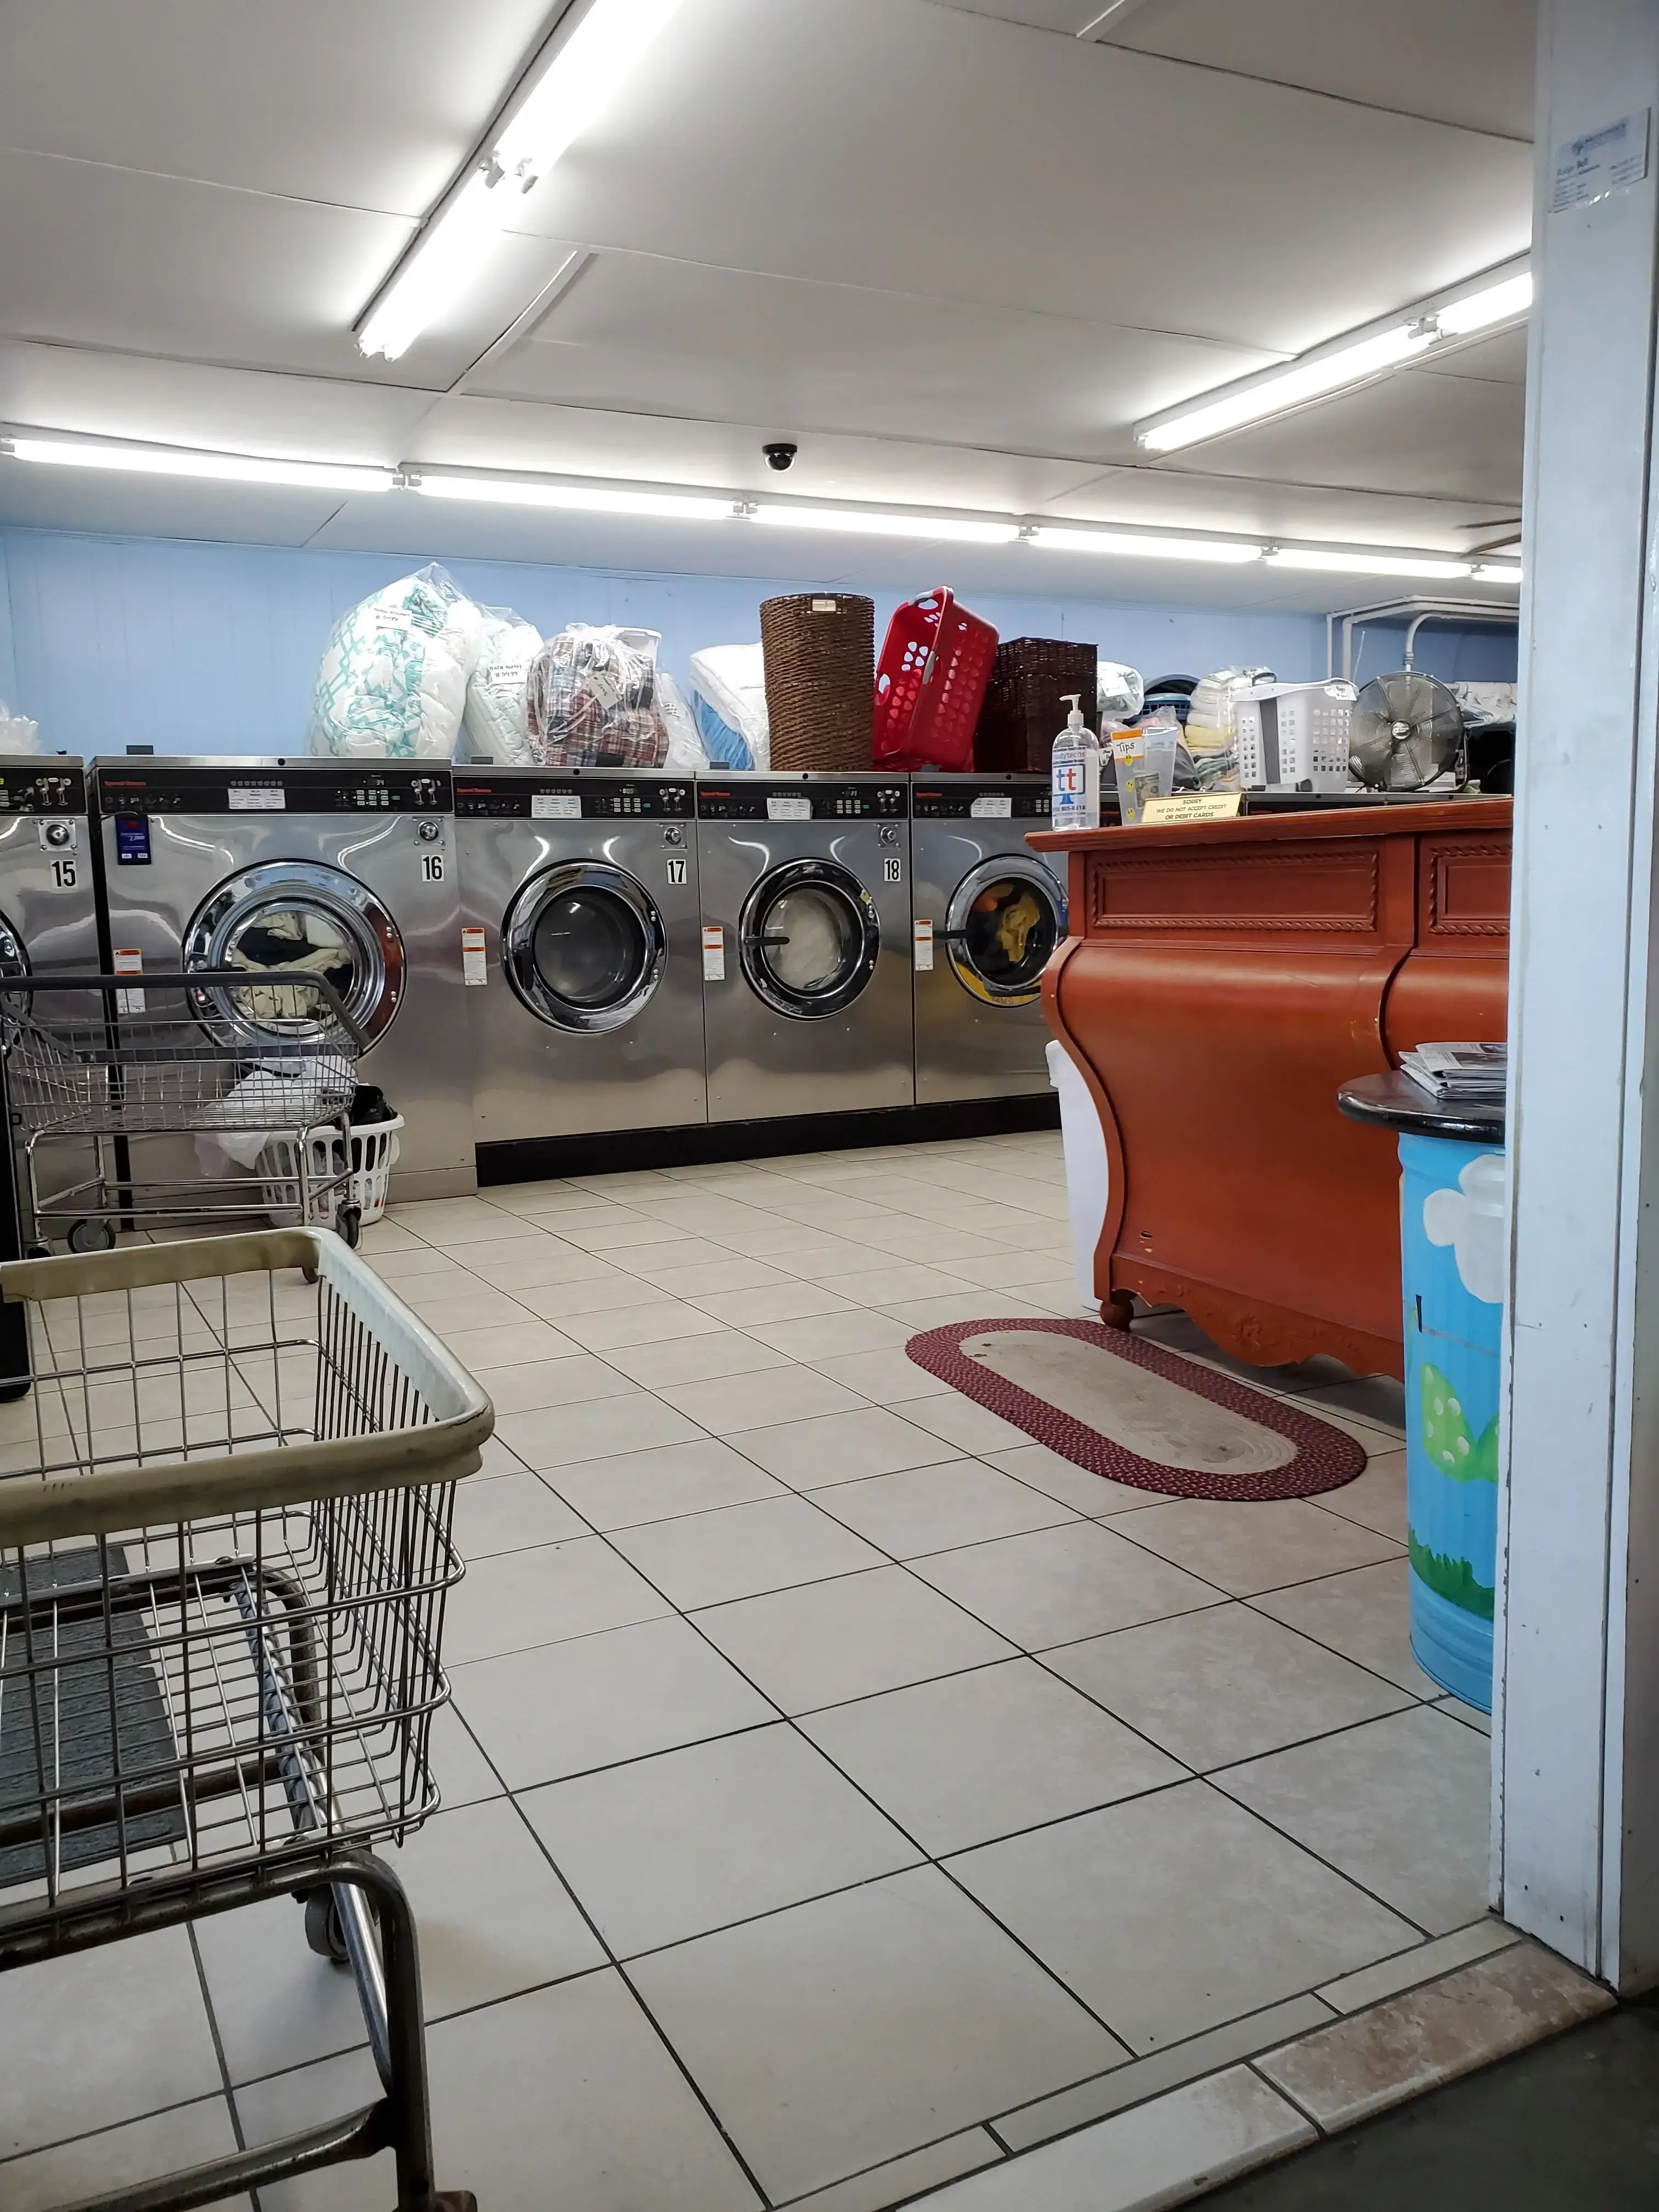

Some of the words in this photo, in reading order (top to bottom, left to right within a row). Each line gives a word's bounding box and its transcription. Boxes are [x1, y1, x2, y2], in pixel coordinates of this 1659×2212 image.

[1116, 742, 1135, 754] Tips
[52, 861, 76, 887] 15
[422, 856, 442, 880] 16
[668, 860, 685, 883] 17
[885, 859, 899, 881] 18
